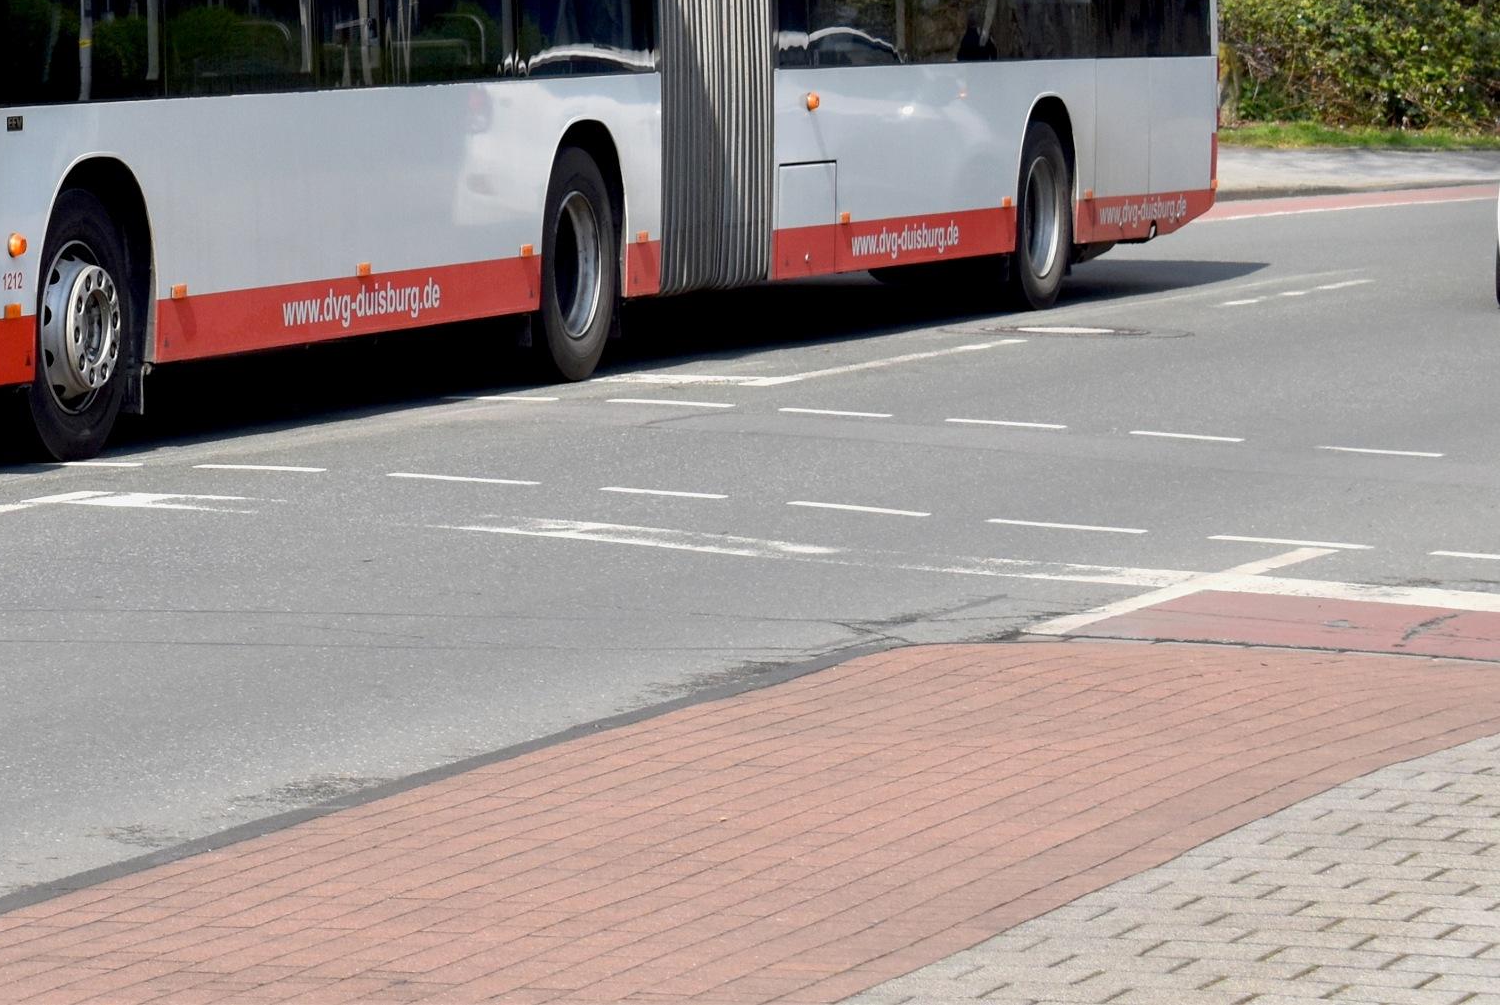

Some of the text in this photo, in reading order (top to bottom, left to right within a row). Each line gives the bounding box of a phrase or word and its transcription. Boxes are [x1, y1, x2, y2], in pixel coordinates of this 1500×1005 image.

[1100, 194, 1187, 228] www.dvg-duisburg.de
[851, 220, 959, 259] www.dvg-duisburg.de
[3, 272, 23, 289] 1212
[283, 277, 441, 327] www.dvg-duisburg.de
